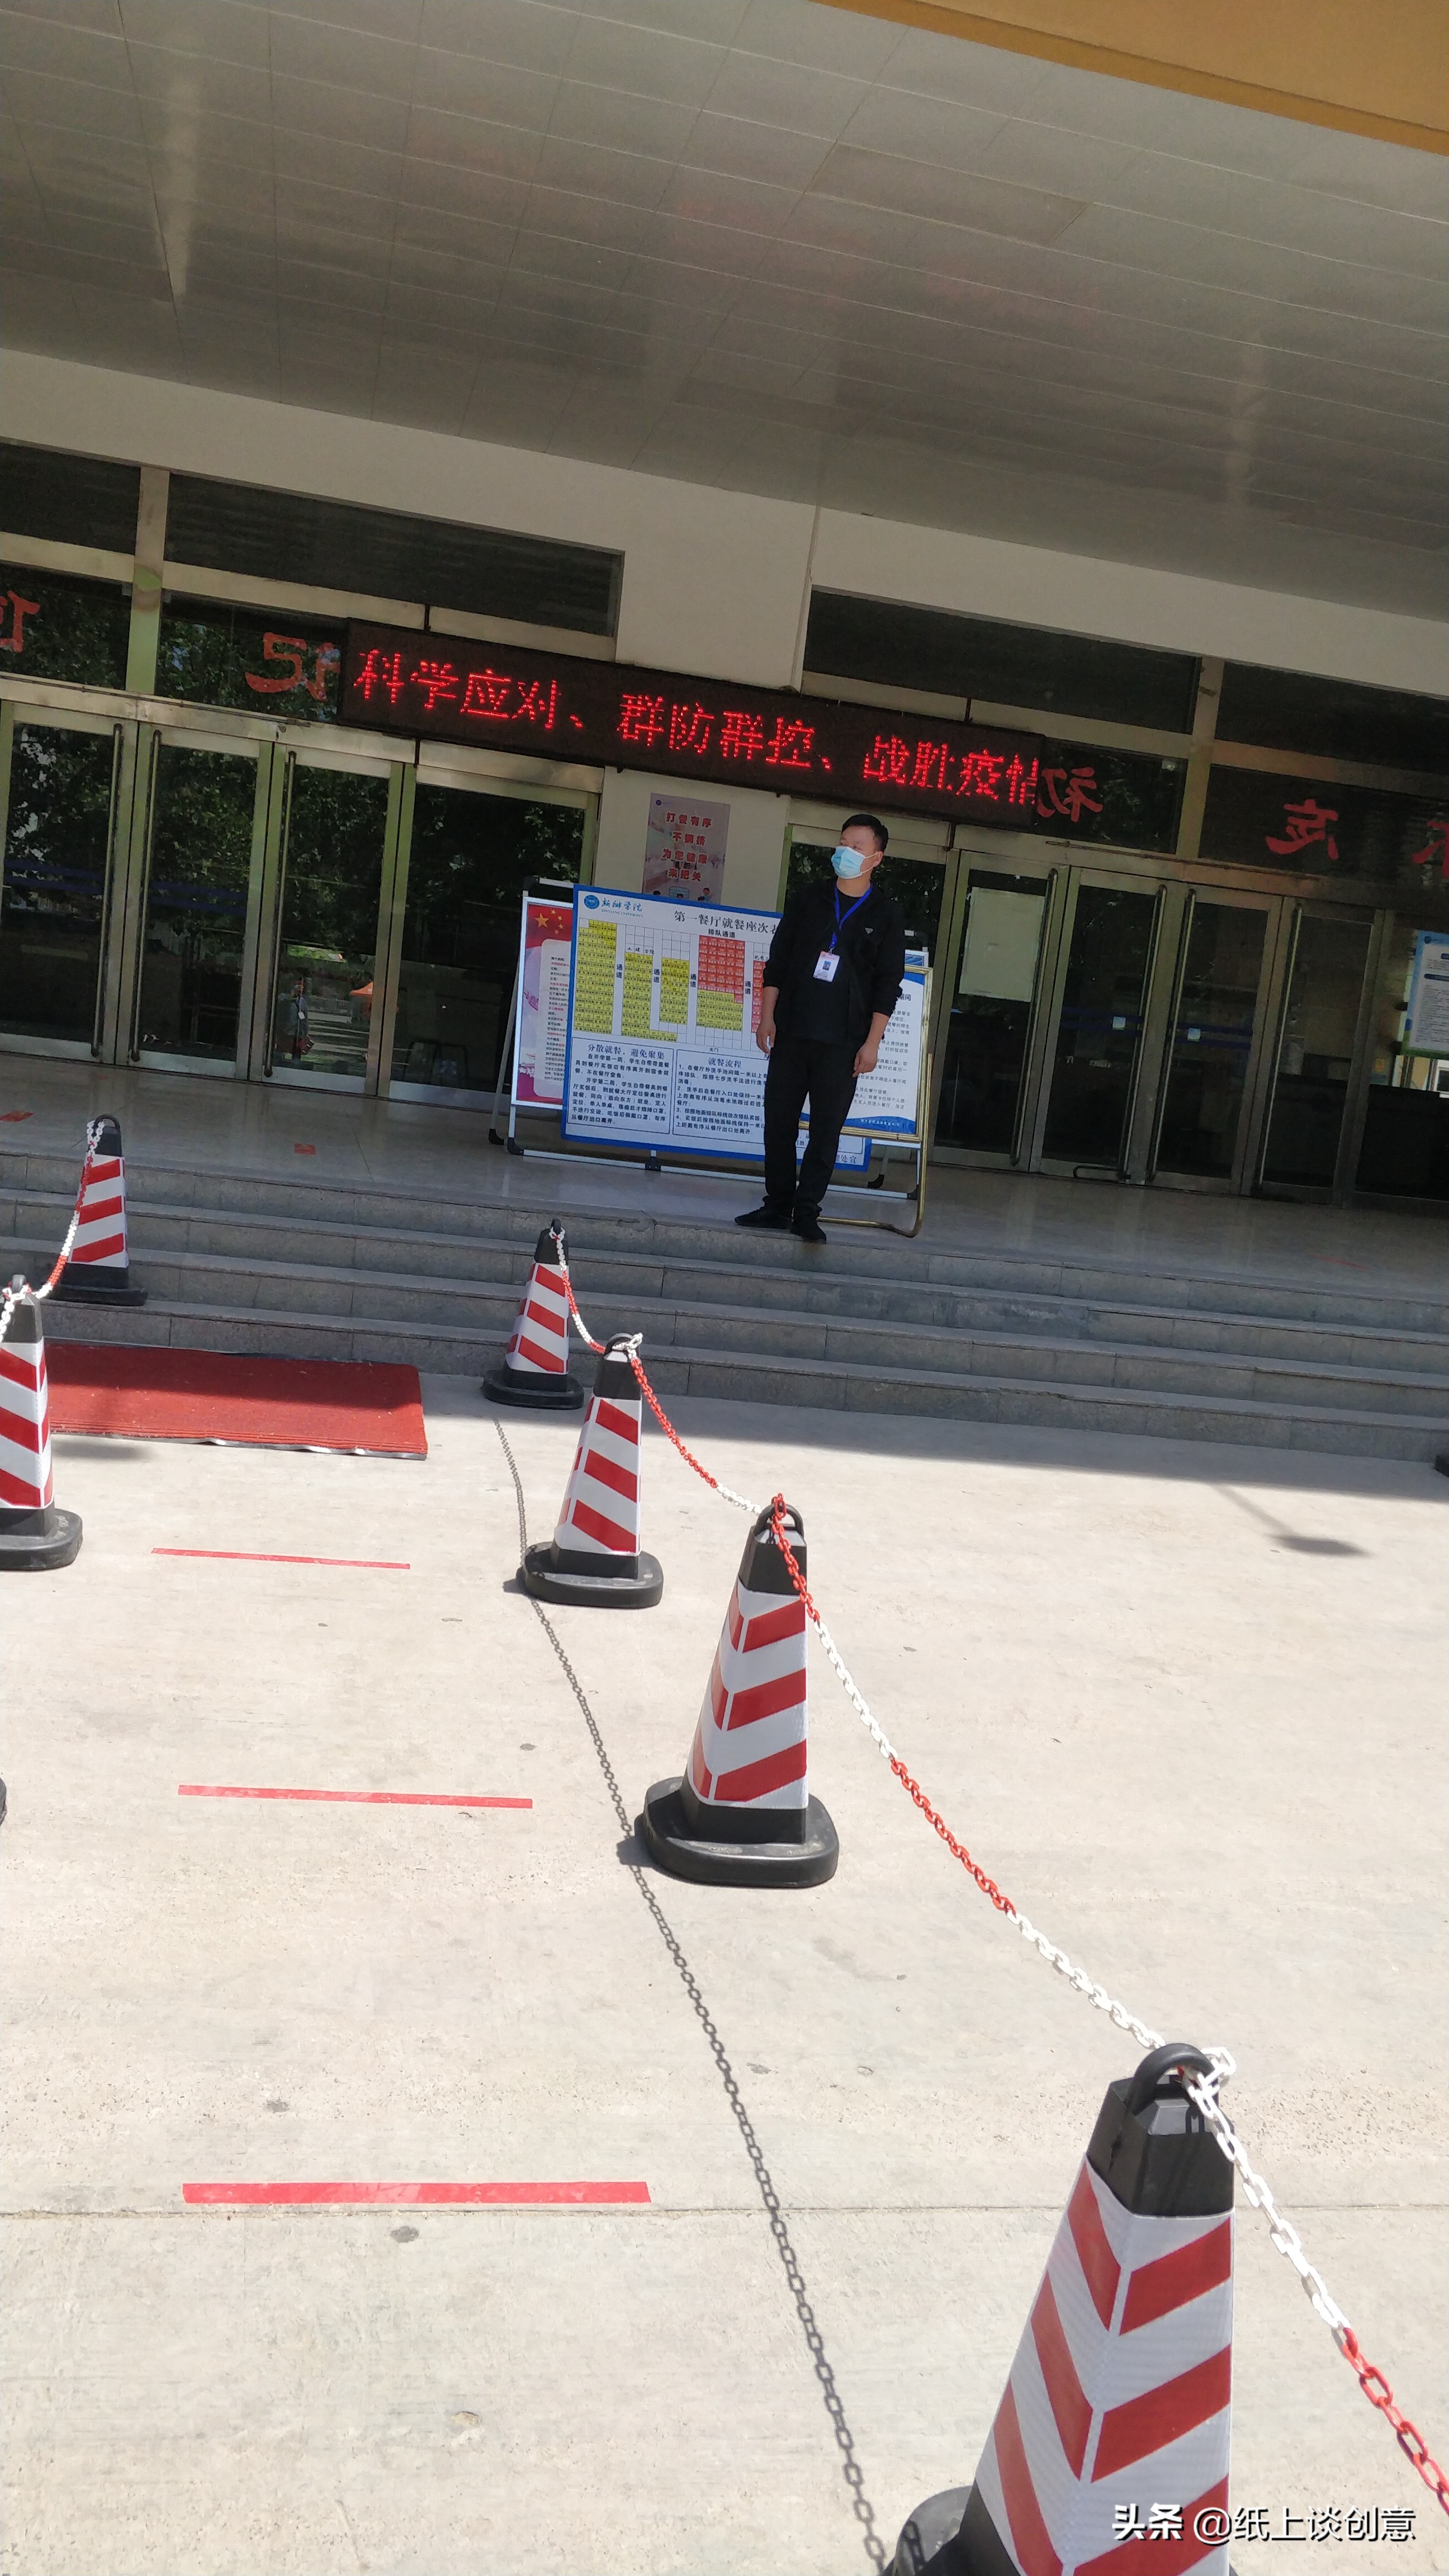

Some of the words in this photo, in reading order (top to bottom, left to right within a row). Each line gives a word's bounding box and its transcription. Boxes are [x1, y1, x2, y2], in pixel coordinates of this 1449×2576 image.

[666, 812, 712, 827] 打餐有序
[673, 832, 705, 846] 不拥挤
[662, 849, 708, 864] 为您健康
[669, 868, 701, 882] 来把关
[708, 929, 736, 938] 排队通道
[616, 964, 623, 978] 通道
[653, 969, 660, 983] 通道
[690, 973, 697, 988] 通道
[745, 981, 751, 995] 通道
[588, 1043, 665, 1060] 分散就餐，避免聚集
[708, 1057, 742, 1068] 就餐流程
